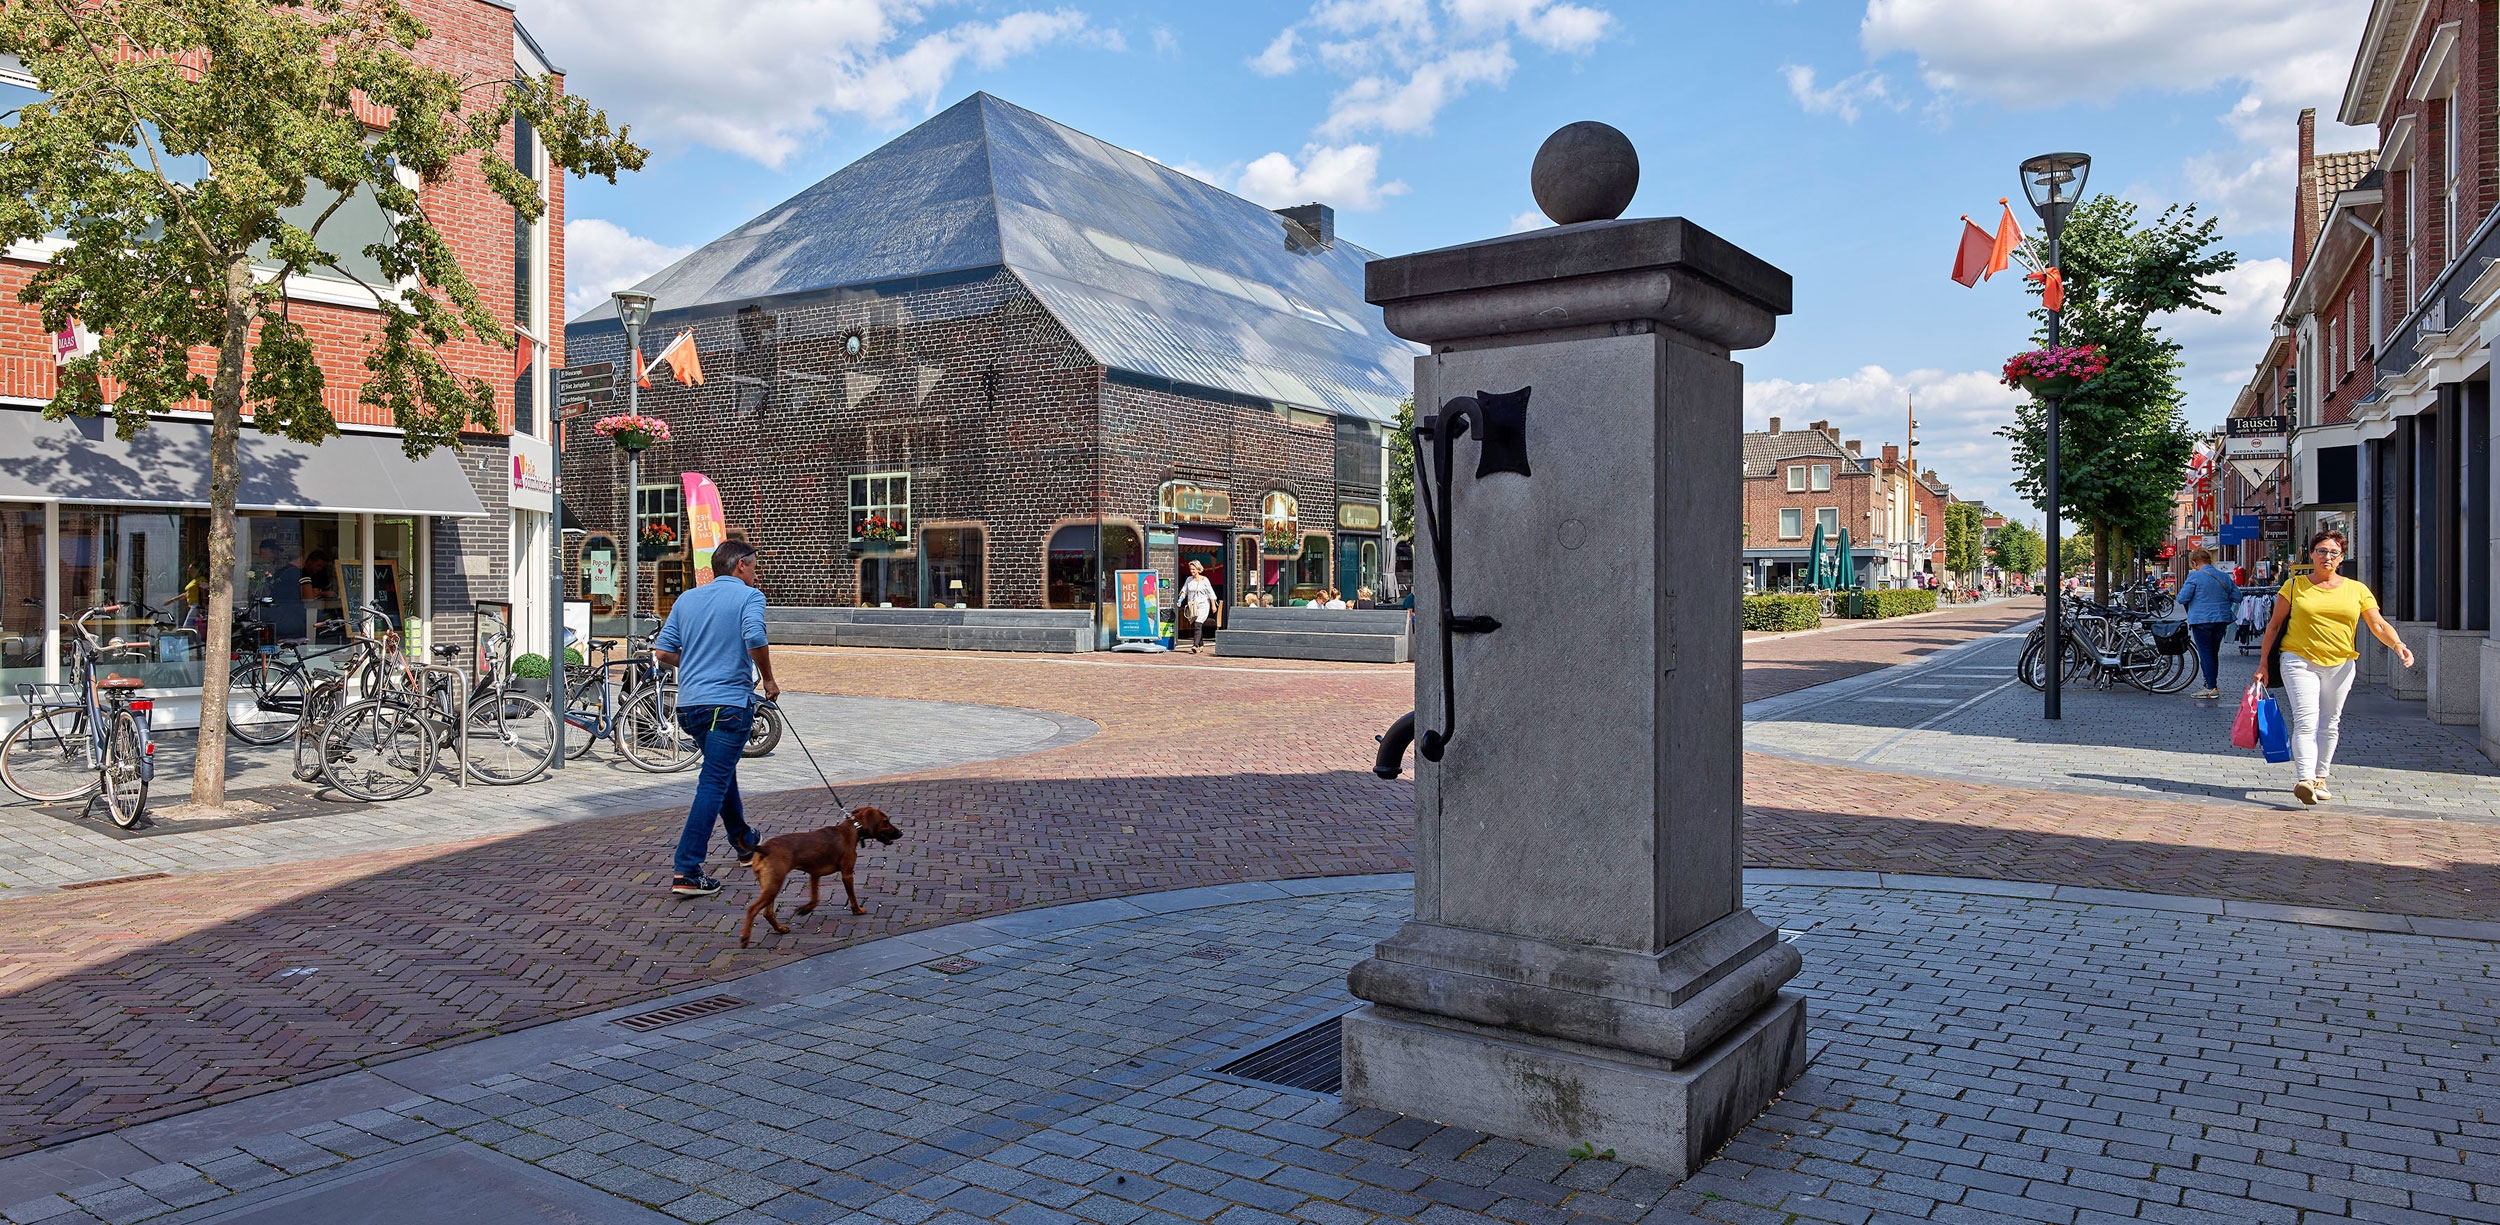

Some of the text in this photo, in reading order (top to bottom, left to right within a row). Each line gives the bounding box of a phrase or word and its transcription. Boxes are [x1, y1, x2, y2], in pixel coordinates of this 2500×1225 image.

[58, 335, 75, 350] MAAS
[2234, 417, 2278, 429] Tausch
[2197, 460, 2213, 530] HEMA
[592, 559, 610, 567] Pop-up
[1122, 583, 1137, 591] HET
[1123, 591, 1137, 602] IJS
[1123, 602, 1137, 610] CAFÉ
